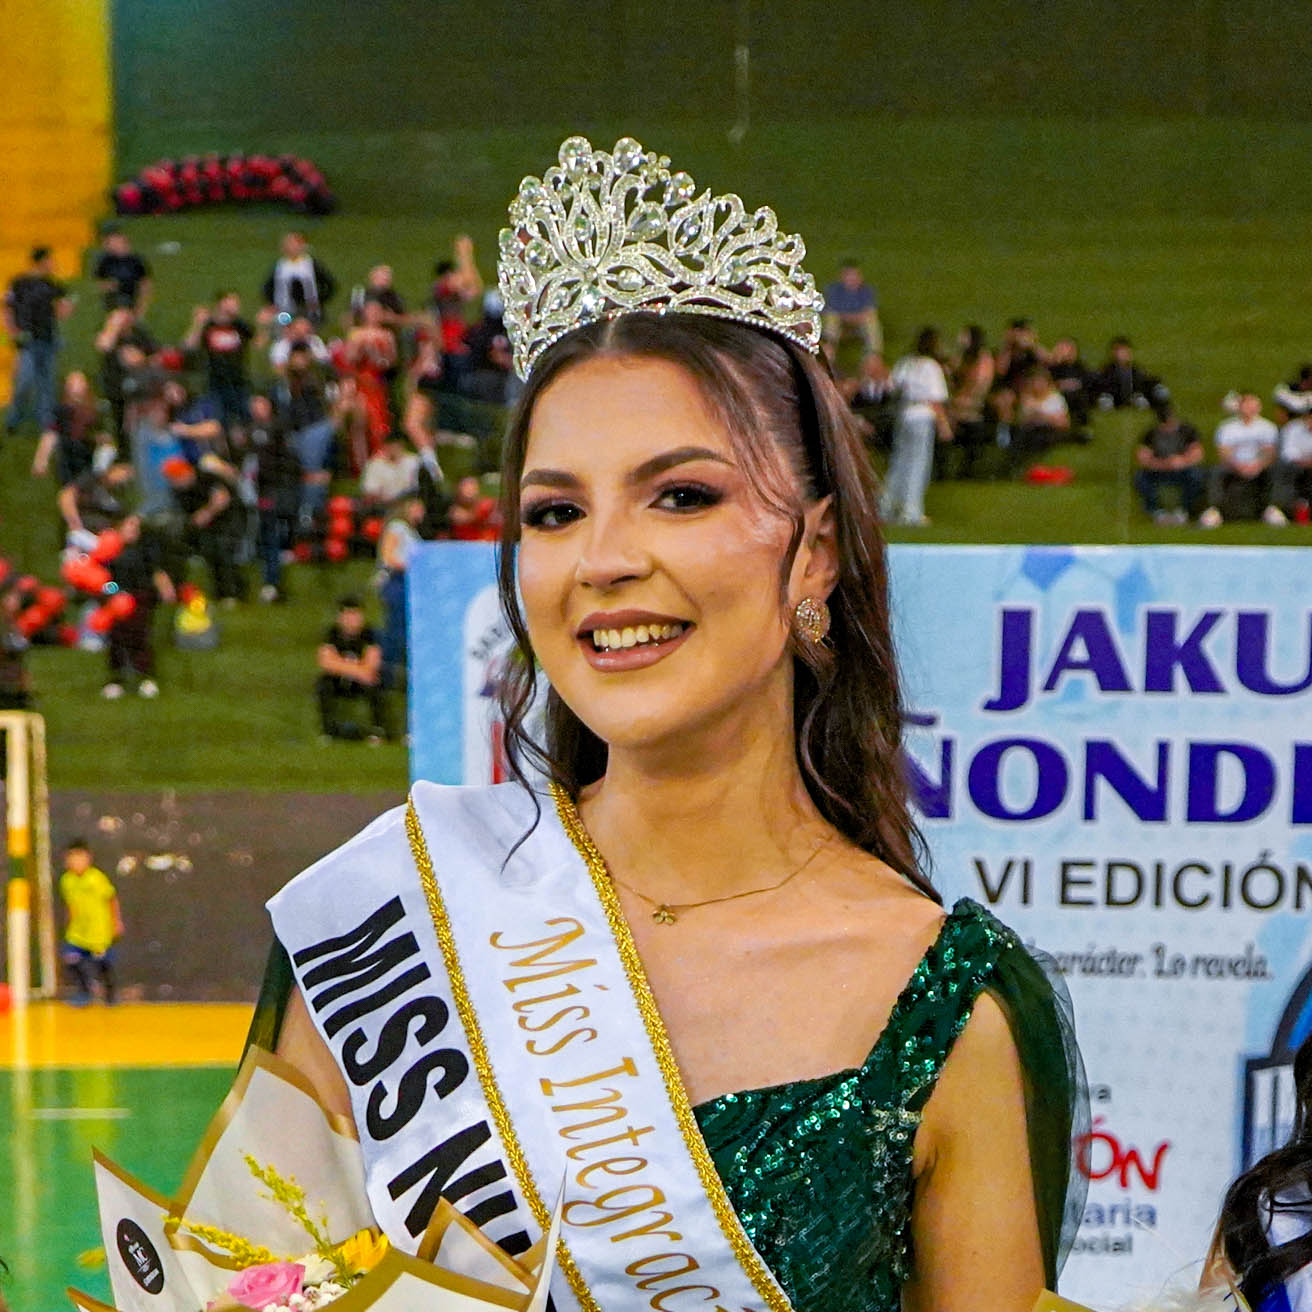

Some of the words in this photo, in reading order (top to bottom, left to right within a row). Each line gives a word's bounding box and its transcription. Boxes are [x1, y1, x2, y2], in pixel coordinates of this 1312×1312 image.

[973, 858, 1033, 905] VI
[292, 896, 471, 1144] MISS
[490, 917, 598, 1058] Miss
